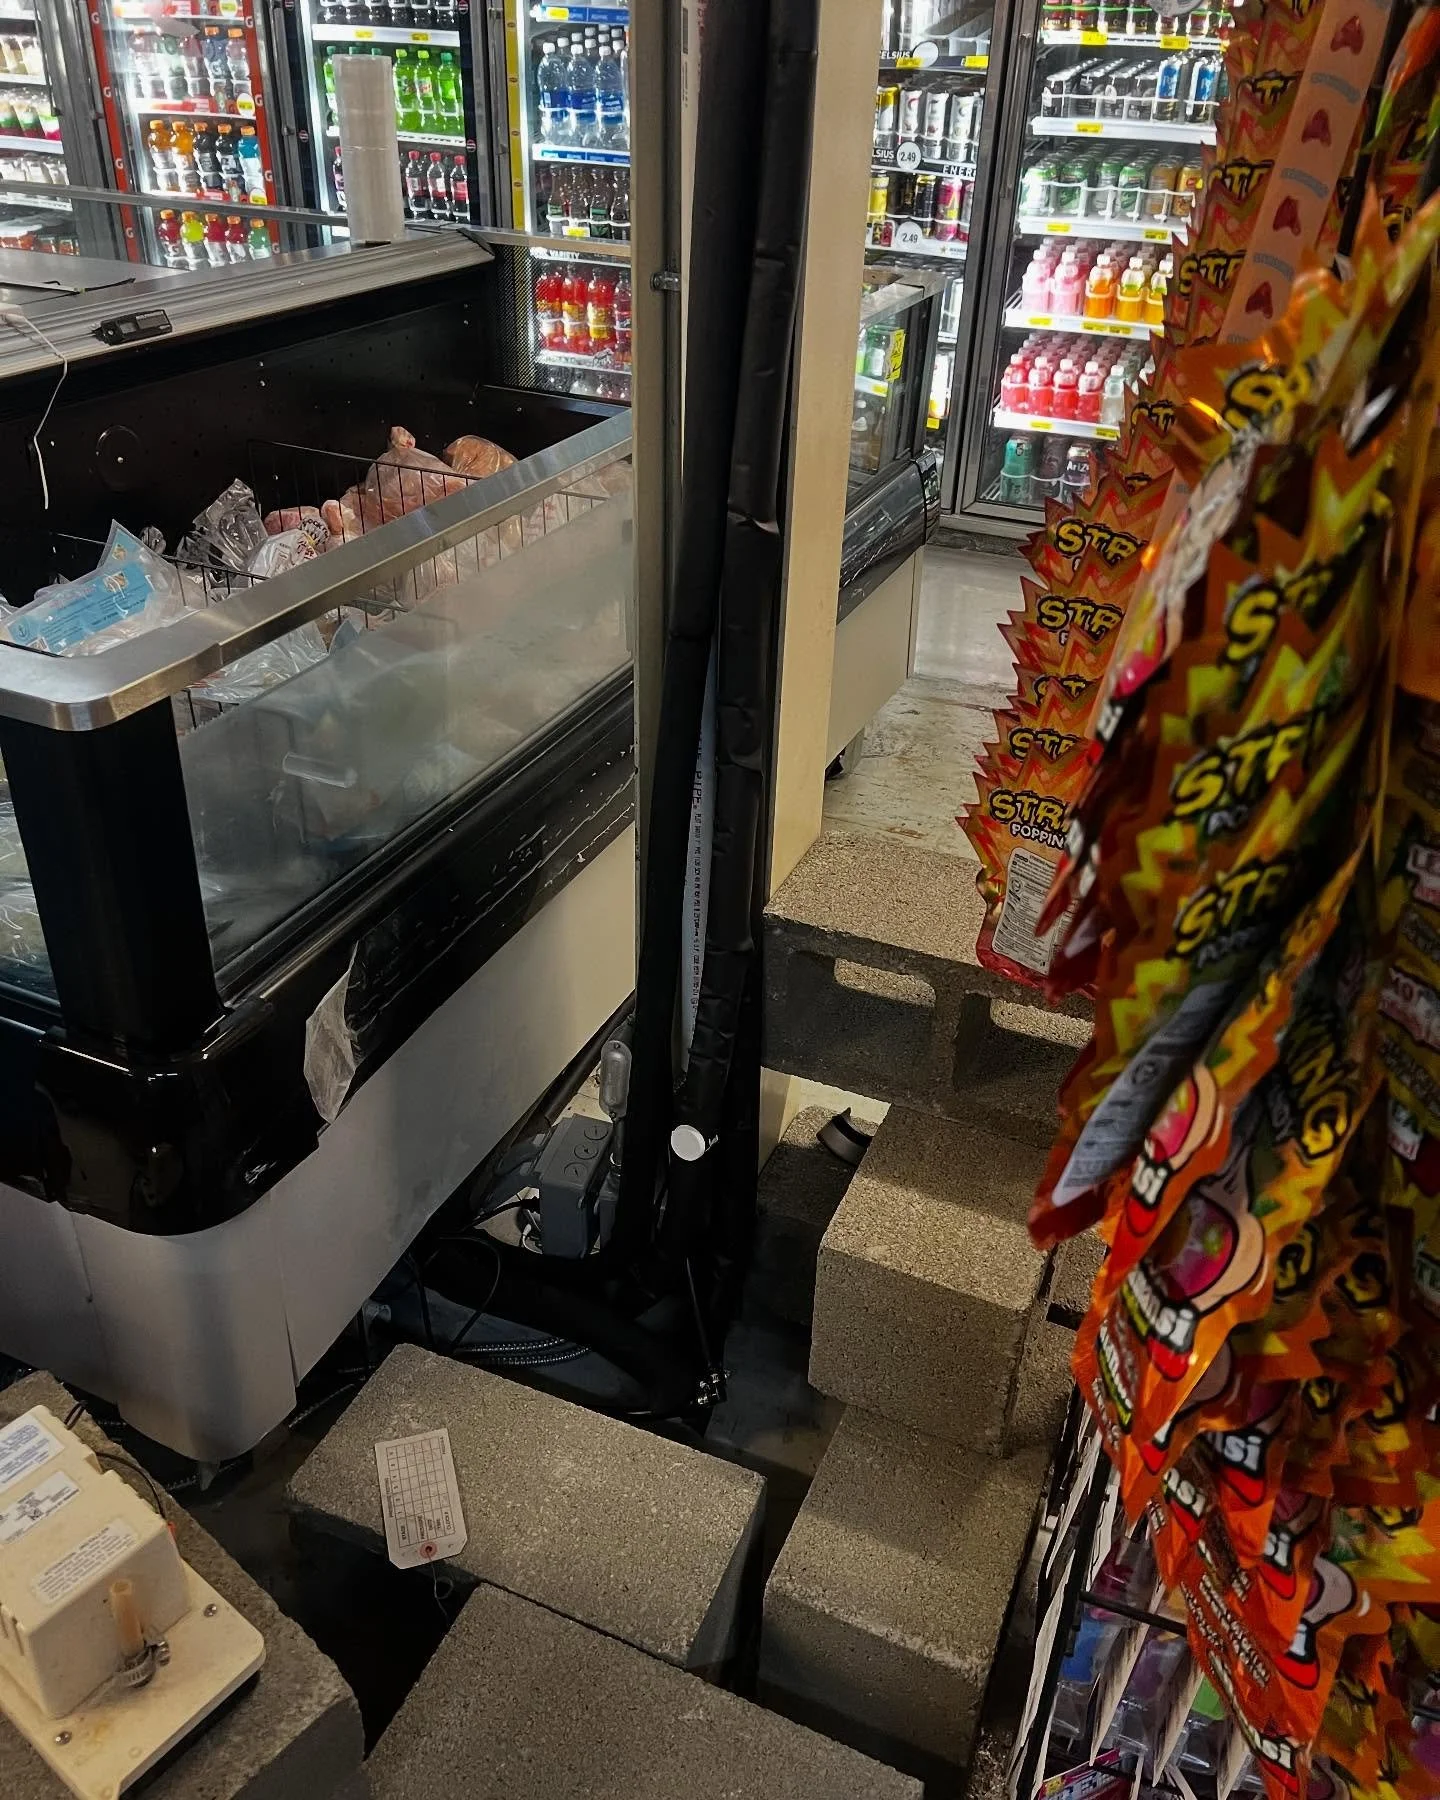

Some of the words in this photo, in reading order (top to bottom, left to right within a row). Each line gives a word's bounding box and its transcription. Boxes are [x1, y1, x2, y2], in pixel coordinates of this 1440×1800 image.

[91, 12, 100, 24] G
[245, 16, 254, 28] G
[103, 86, 112, 98] G
[255, 94, 264, 106] G
[115, 158, 124, 170] G
[264, 170, 273, 182] G
[126, 227, 134, 239] G
